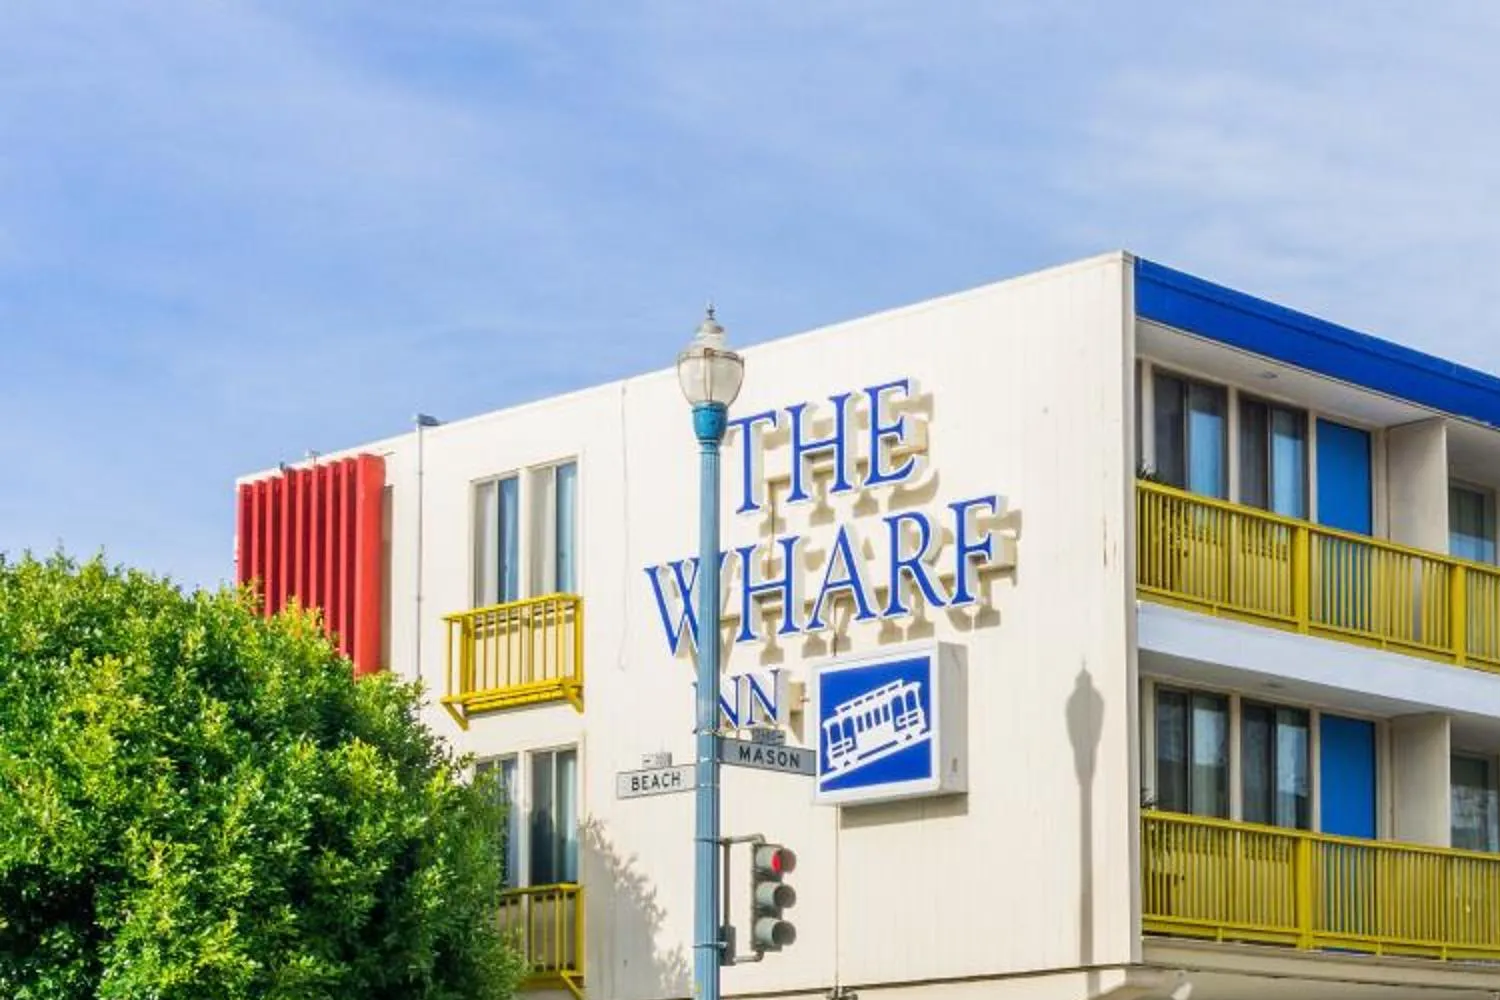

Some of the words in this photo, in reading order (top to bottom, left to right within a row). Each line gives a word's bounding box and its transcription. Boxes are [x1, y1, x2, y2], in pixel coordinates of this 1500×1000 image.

[727, 377, 918, 516] THE
[643, 494, 1002, 656] WHARF
[692, 668, 781, 734] NN
[631, 771, 681, 791] BEACH
[739, 745, 800, 768] MASON
